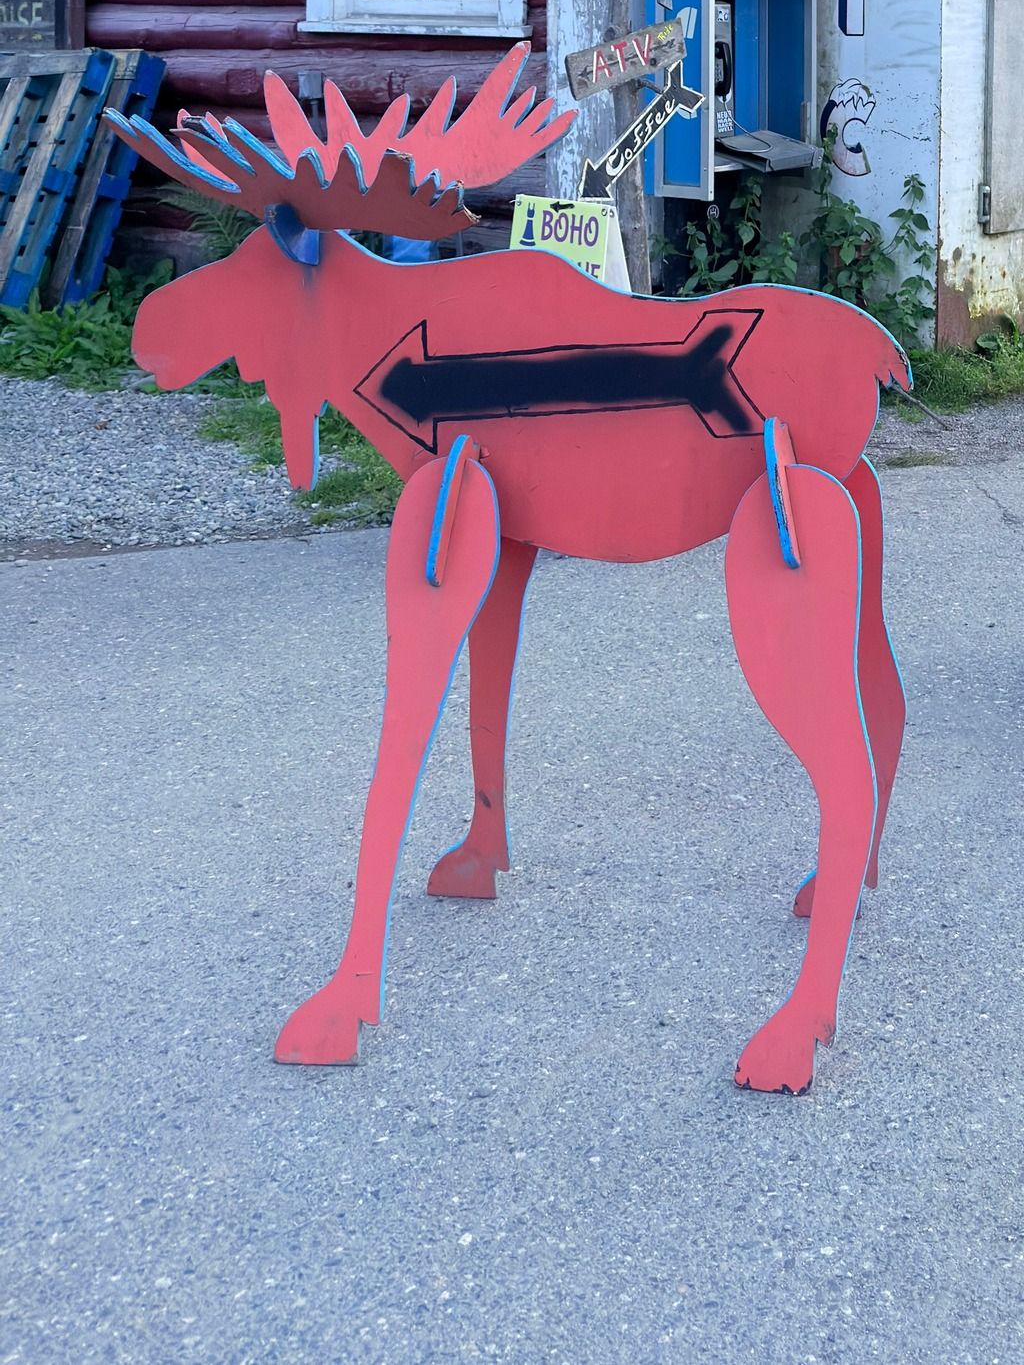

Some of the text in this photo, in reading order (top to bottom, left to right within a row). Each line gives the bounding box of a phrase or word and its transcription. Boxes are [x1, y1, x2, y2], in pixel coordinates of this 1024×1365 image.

[592, 34, 653, 83] ATV
[606, 98, 675, 176] Coffee
[541, 210, 599, 247] BOHO
